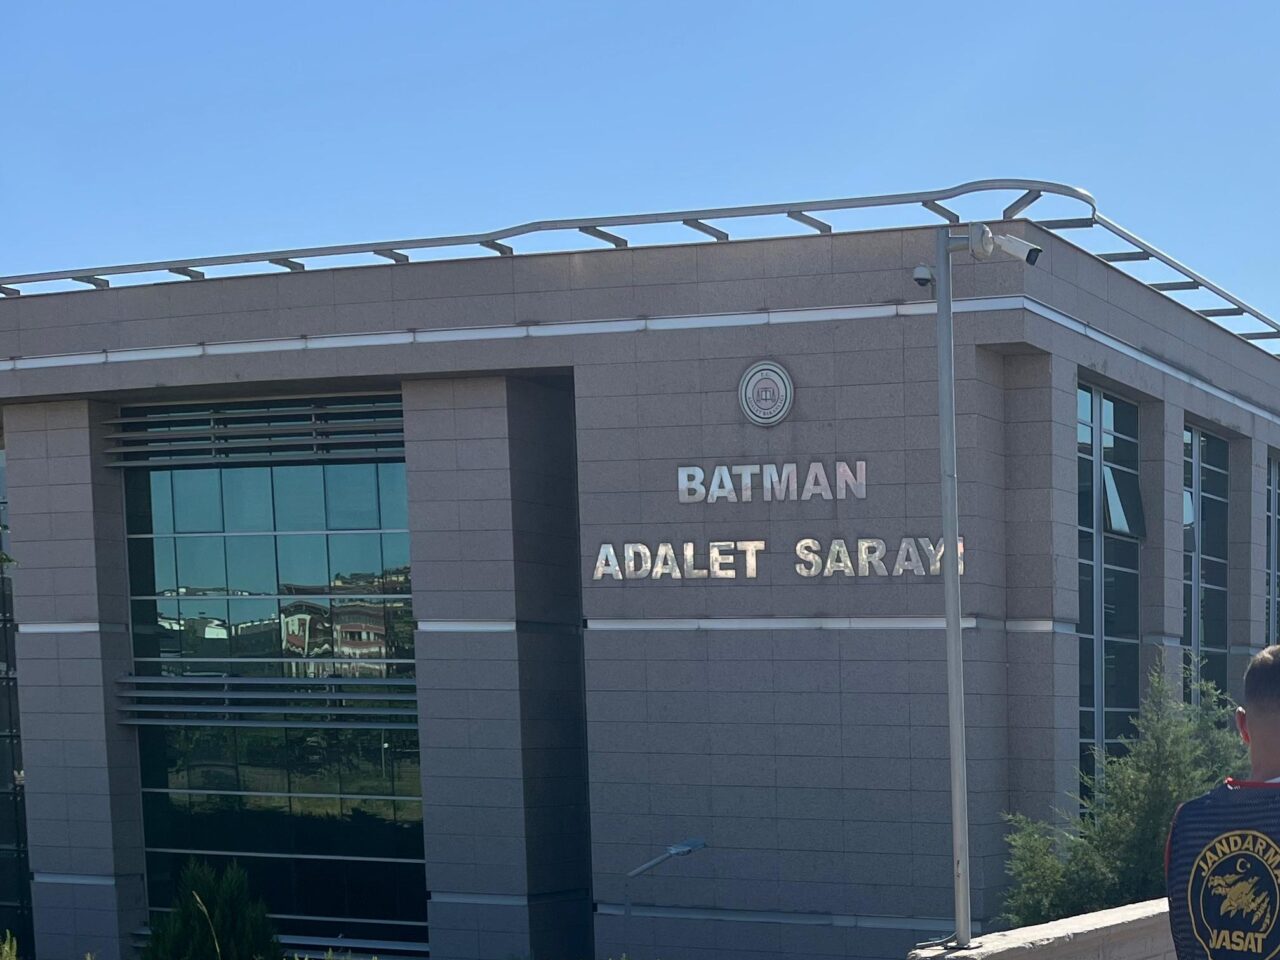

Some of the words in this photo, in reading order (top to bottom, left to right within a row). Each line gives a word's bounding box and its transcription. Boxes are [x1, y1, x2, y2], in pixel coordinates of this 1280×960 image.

[677, 461, 867, 503] BATMAN
[592, 540, 766, 580] ADALET
[1209, 929, 1268, 953] JASAT
